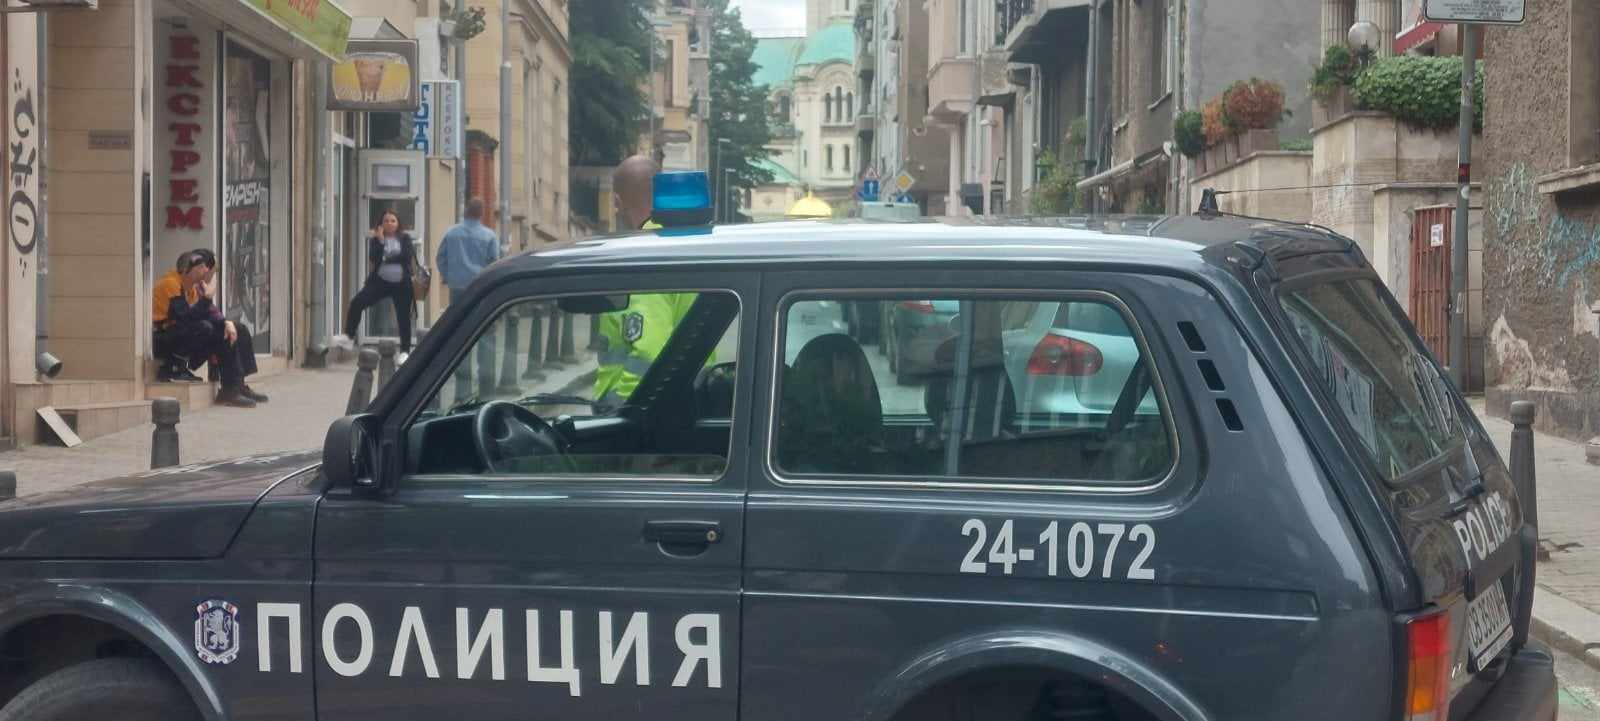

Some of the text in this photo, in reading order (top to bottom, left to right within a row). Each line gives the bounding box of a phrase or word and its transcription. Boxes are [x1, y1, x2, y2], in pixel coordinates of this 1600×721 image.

[165, 34, 204, 231] ЕКСТРЕМ
[959, 518, 1156, 580] 24-1072
[1453, 491, 1511, 570] POLICE
[256, 602, 722, 697] ПОЛИЦИЯ
